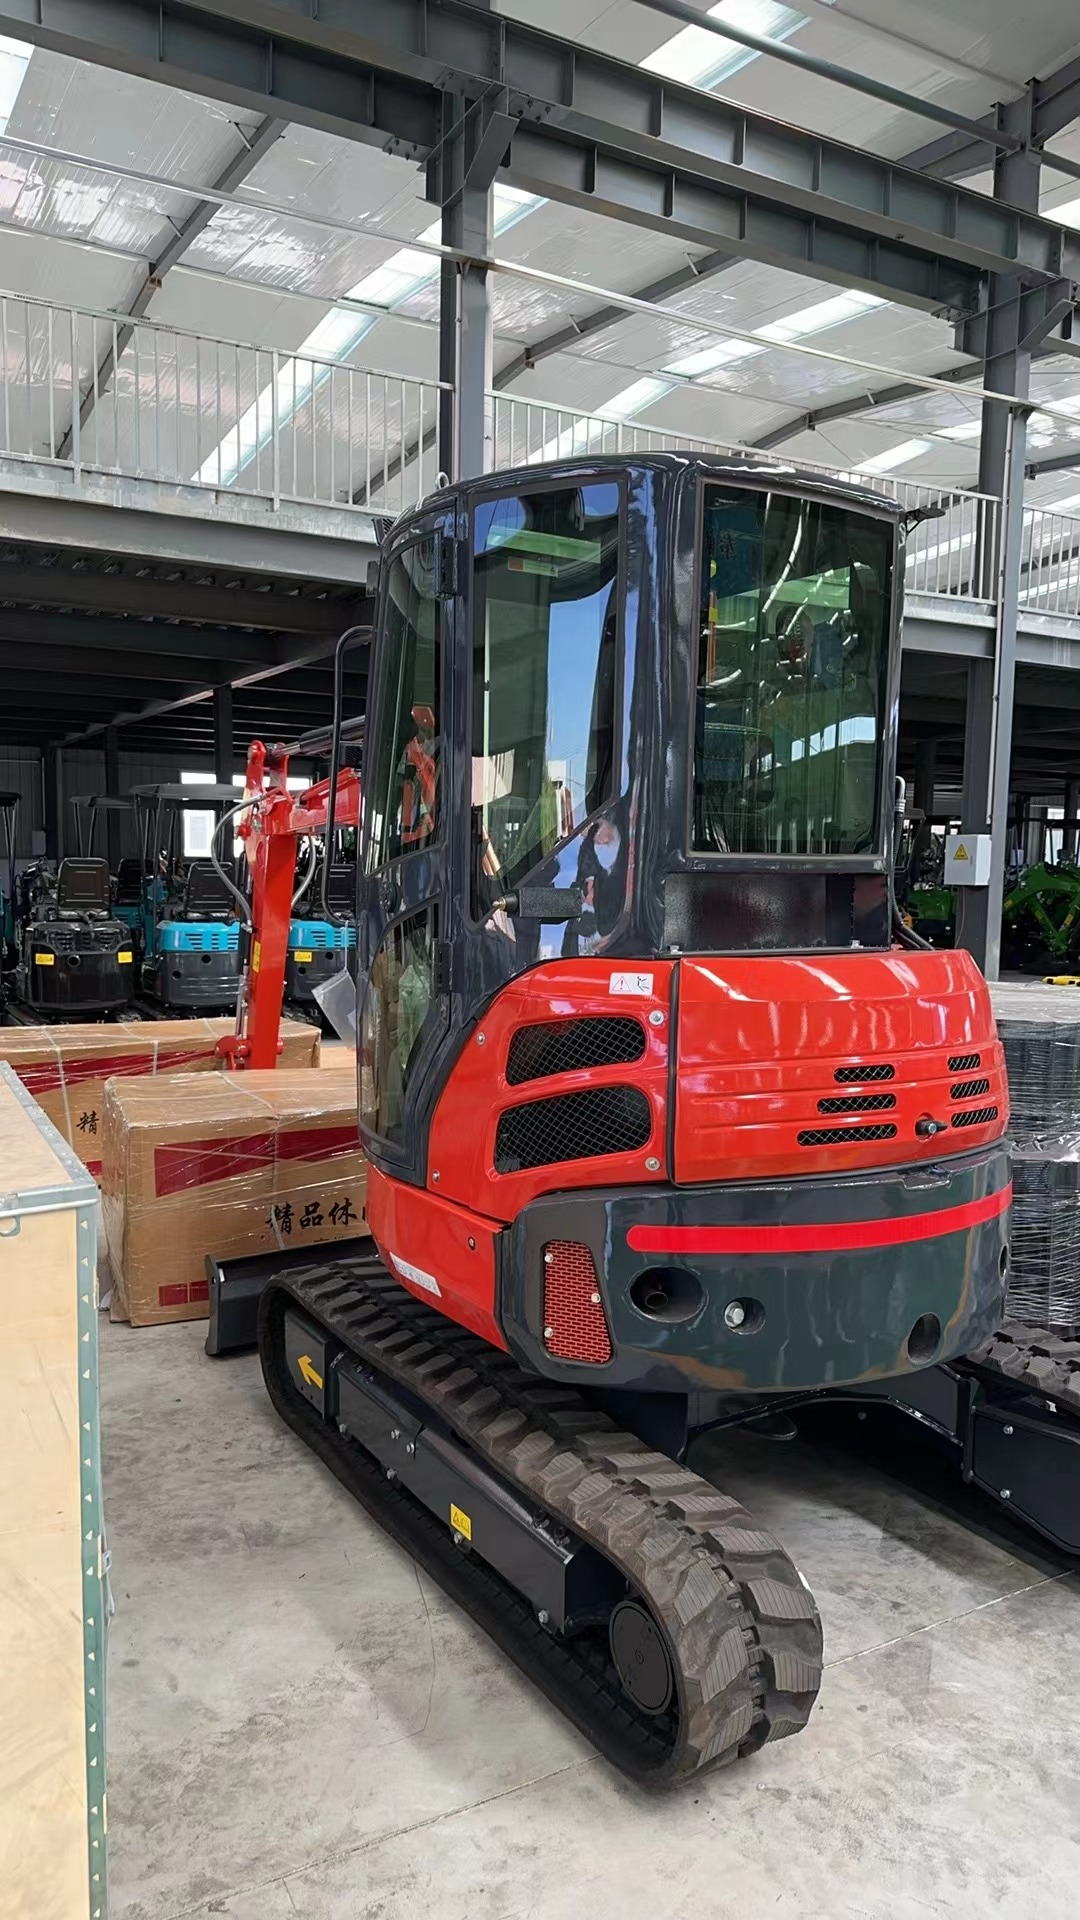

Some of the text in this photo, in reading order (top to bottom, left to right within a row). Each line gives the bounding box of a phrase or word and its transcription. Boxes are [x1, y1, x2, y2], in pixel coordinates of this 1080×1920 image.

[76, 1110, 100, 1135] 精
[265, 1197, 367, 1235] 精品休
